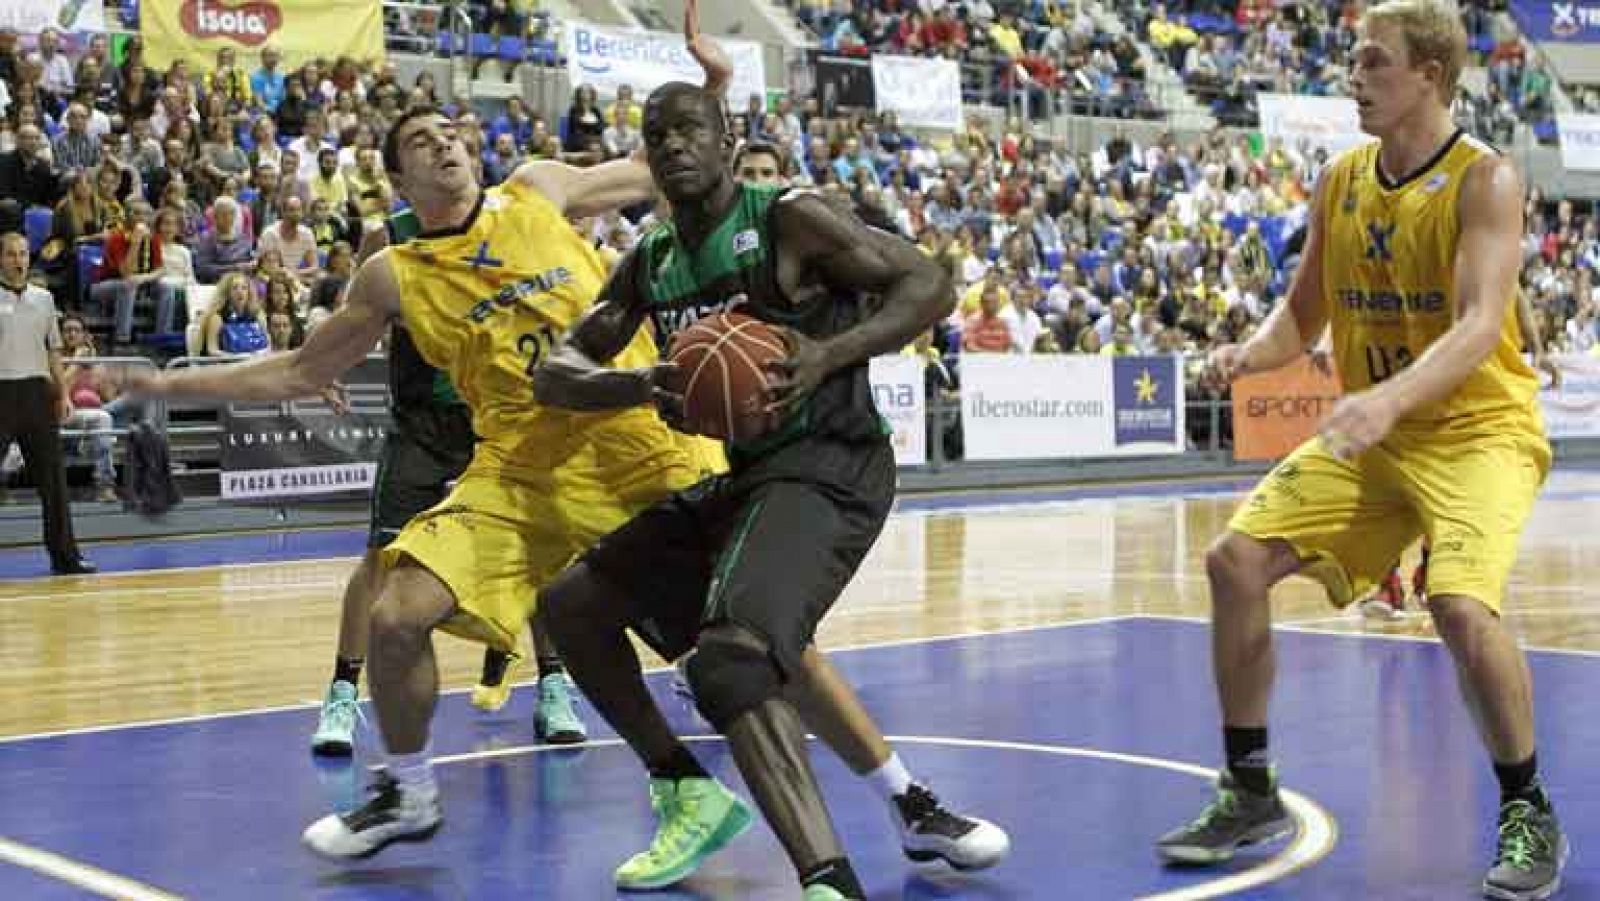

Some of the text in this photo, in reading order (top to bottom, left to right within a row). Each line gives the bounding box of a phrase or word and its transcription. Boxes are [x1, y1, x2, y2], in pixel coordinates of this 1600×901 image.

[970, 391, 1104, 418] iberostar.com
[230, 467, 369, 492] PLAZA CANDELARIA
